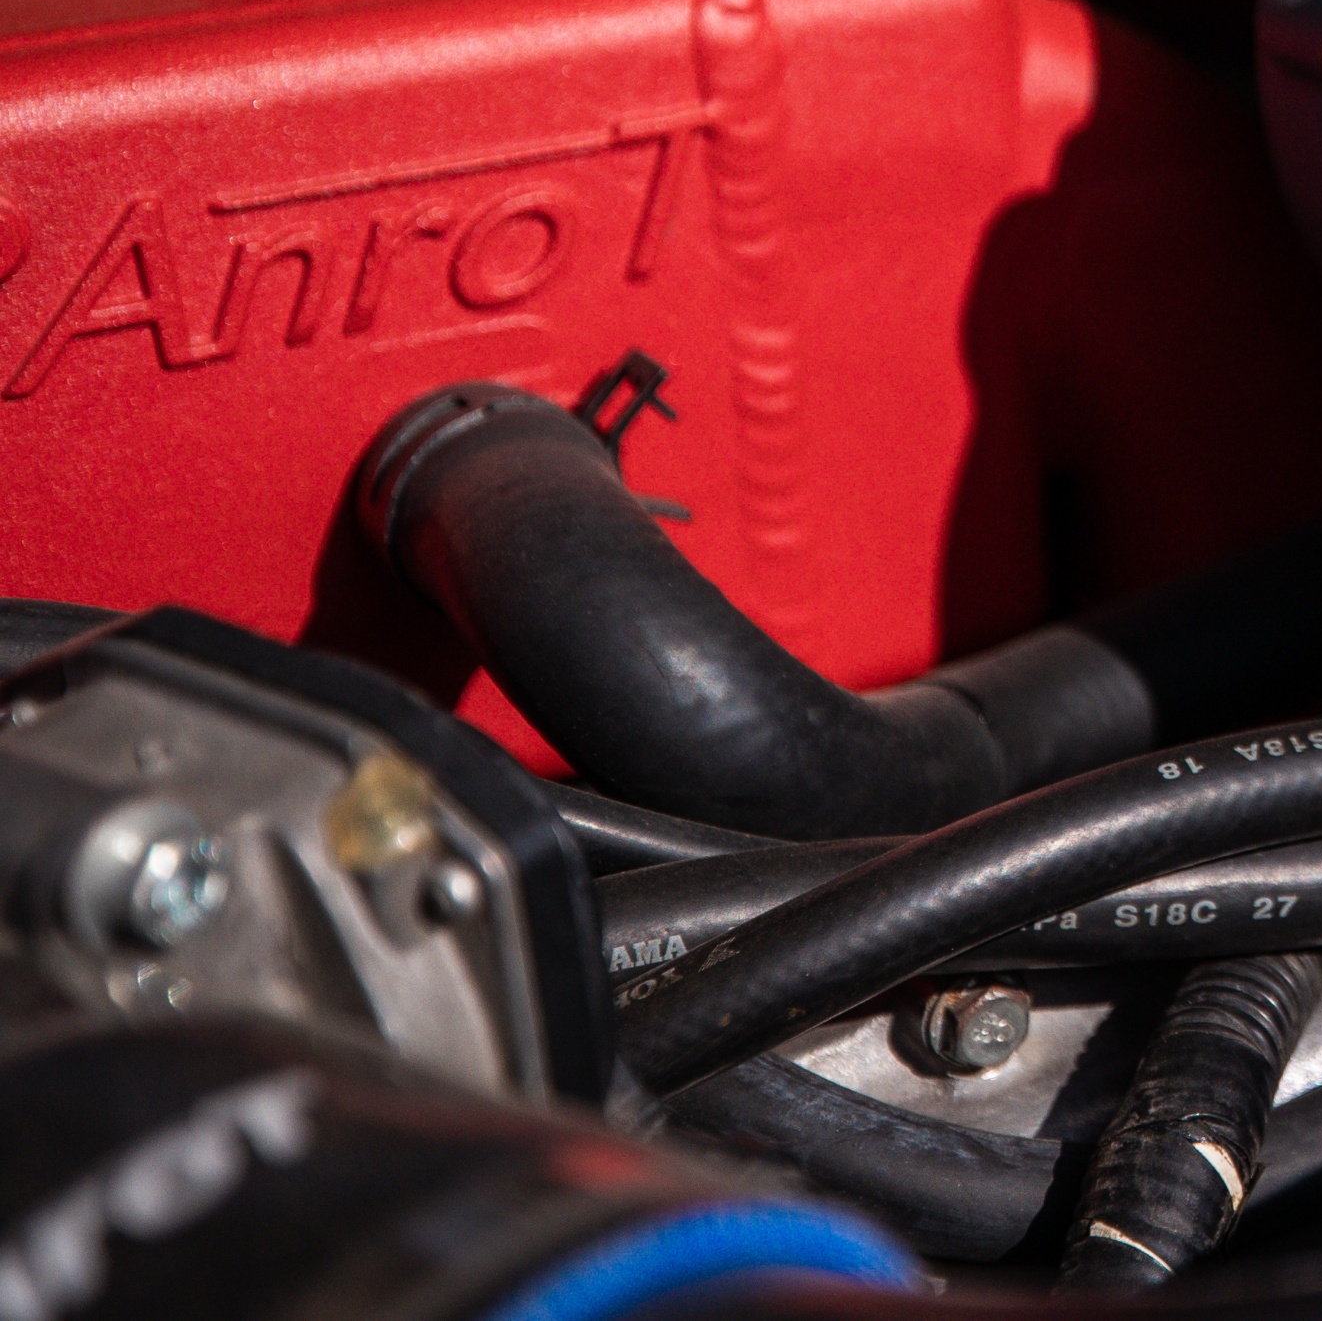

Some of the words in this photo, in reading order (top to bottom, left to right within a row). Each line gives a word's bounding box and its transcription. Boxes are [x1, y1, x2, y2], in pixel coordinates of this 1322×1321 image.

[1156, 755, 1206, 781] 18
[1113, 899, 1219, 929] S18C
[1251, 895, 1299, 921] 27
[605, 933, 689, 974] AMA
